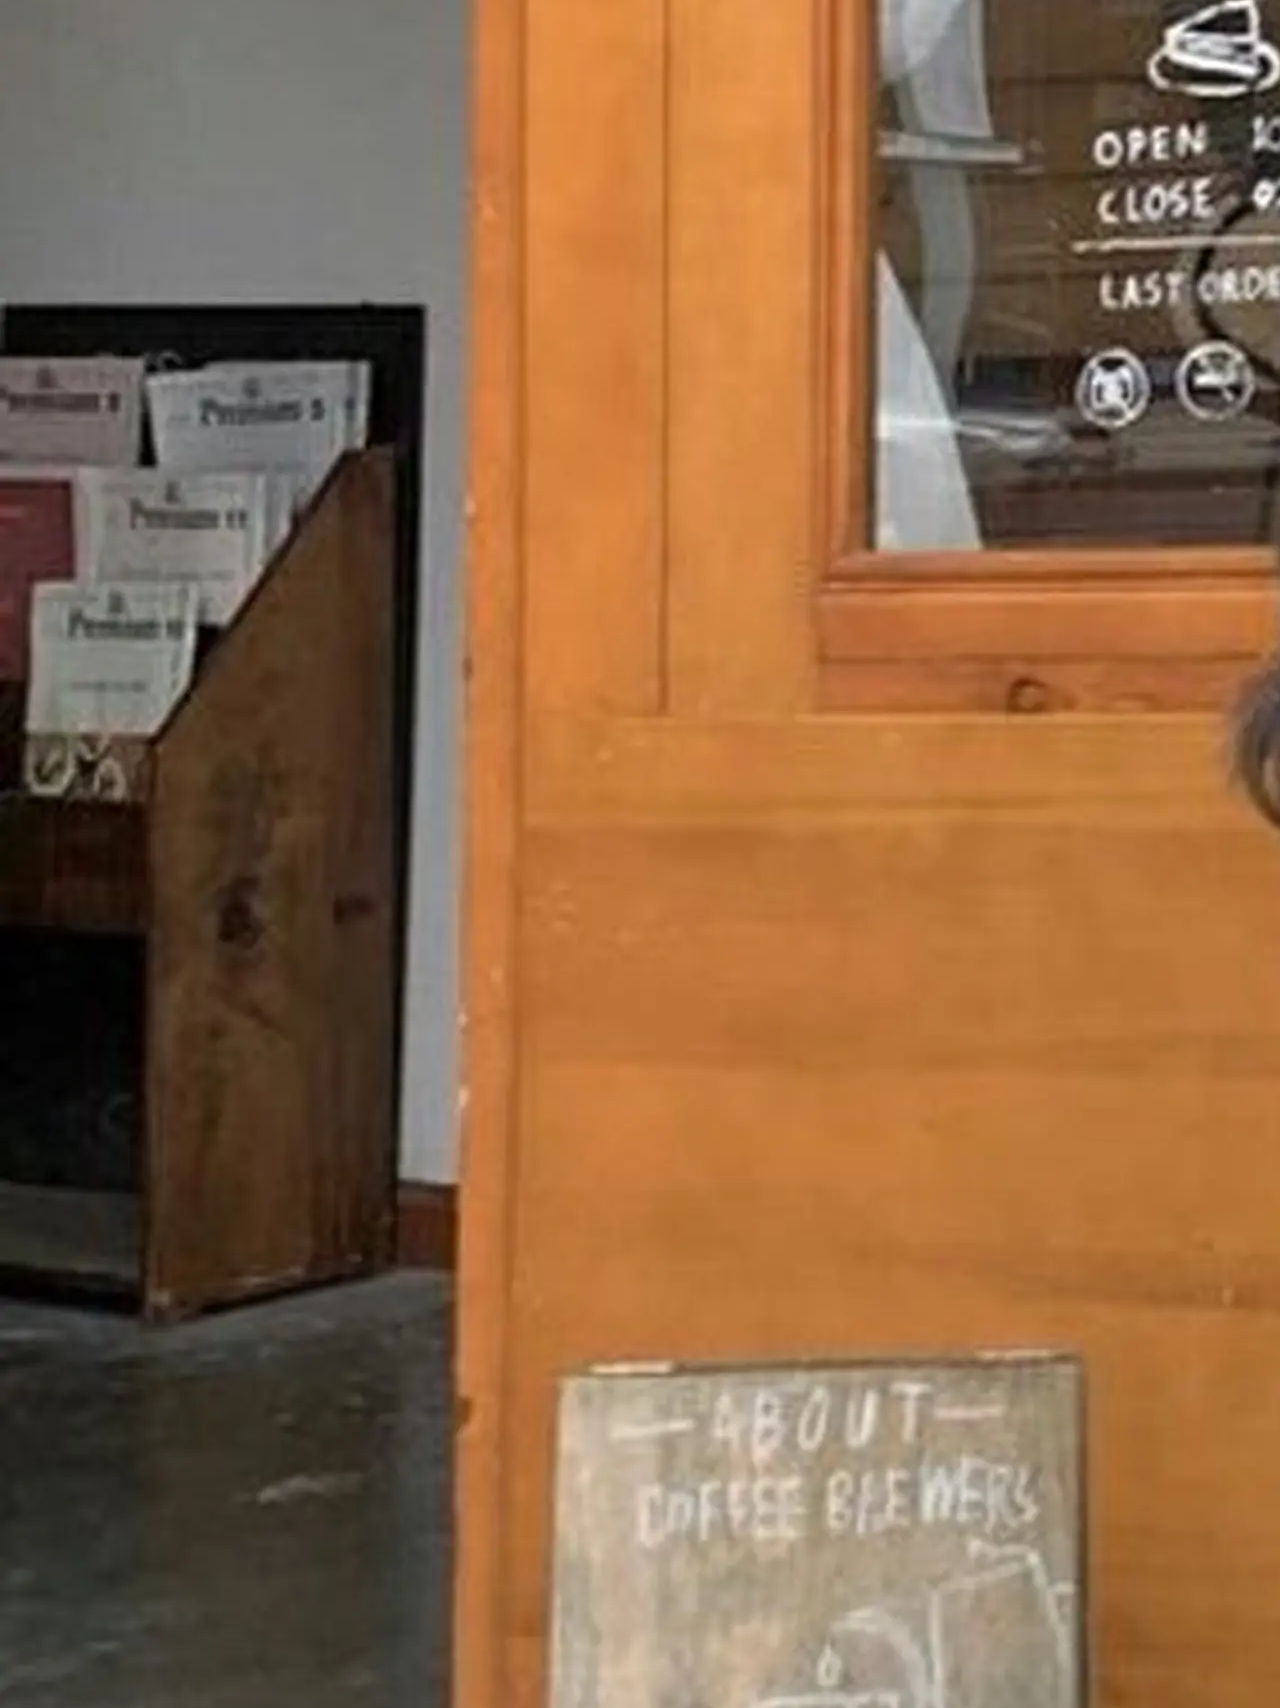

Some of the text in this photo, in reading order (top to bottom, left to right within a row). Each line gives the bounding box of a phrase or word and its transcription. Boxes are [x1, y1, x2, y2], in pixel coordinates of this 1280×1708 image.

[1093, 123, 1208, 166] OPEN
[1096, 176, 1215, 224] CLOSE
[1099, 271, 1189, 311] LAST
[710, 1381, 935, 1454] ABOUT
[635, 1476, 808, 1548] COFFEE
